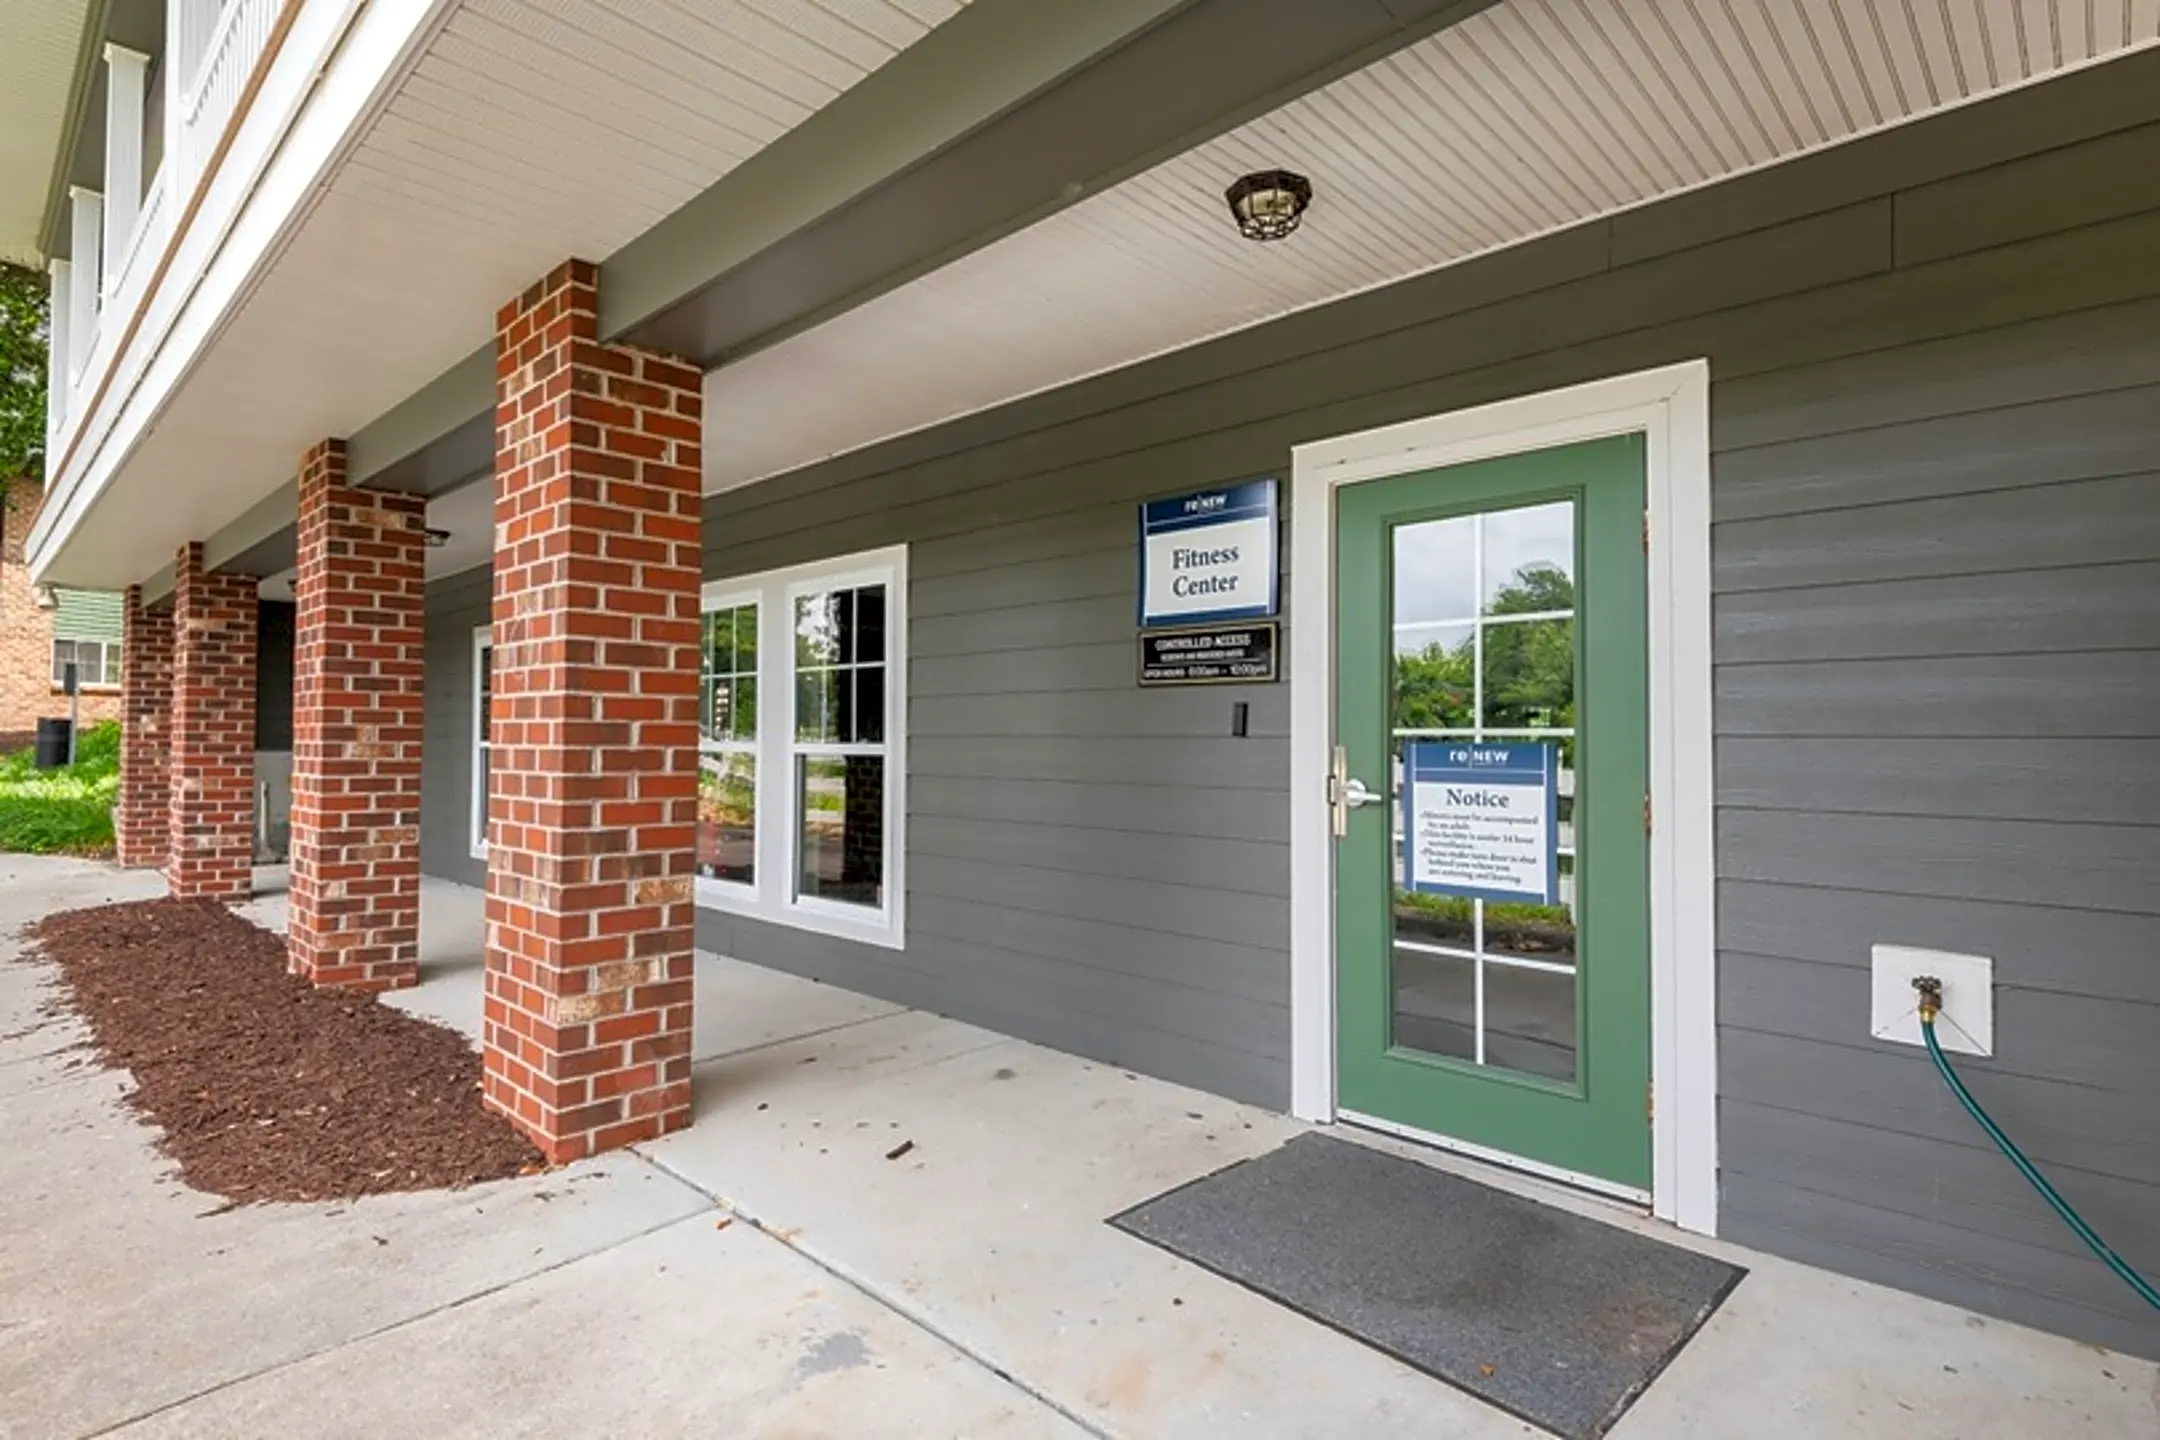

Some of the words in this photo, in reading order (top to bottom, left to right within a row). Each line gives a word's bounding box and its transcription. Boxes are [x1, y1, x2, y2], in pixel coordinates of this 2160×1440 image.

[1172, 546, 1239, 570] Fitness
[1172, 575, 1238, 597] Center
[1154, 636, 1212, 651] CONTROLLED
[1215, 633, 1251, 647] ACCESS
[1446, 788, 1510, 808] Notice
